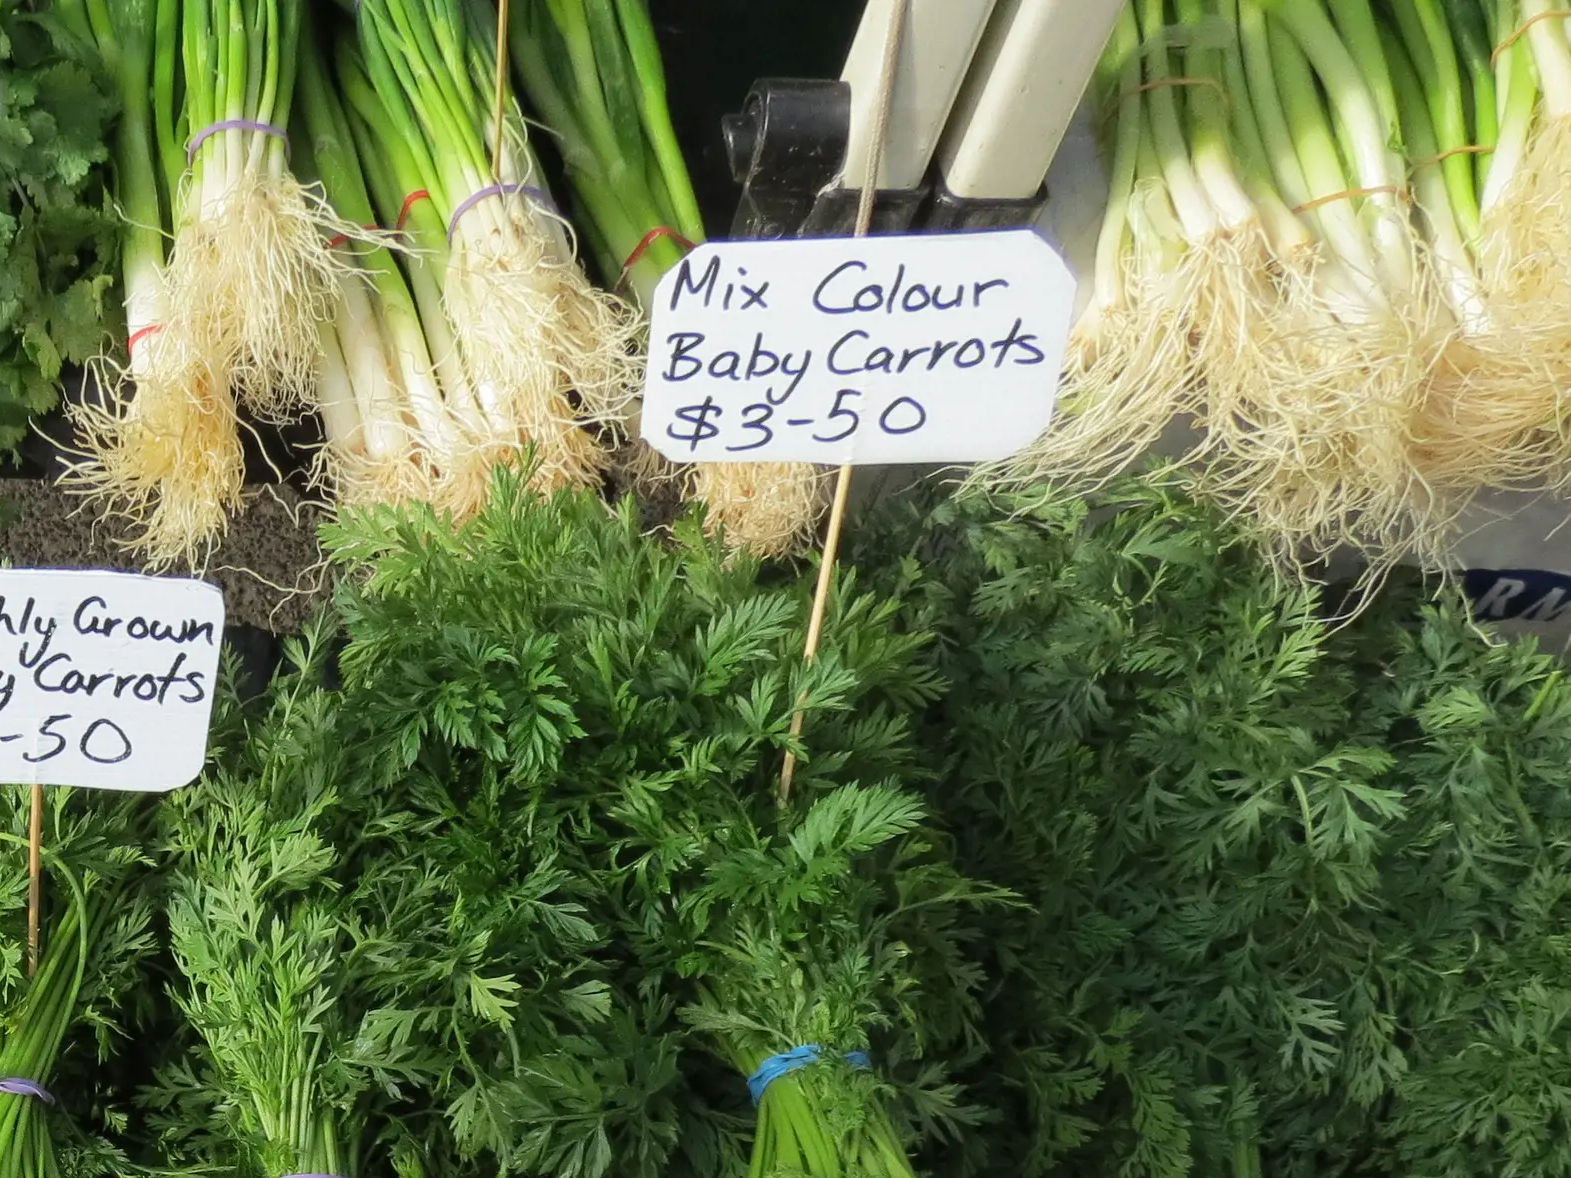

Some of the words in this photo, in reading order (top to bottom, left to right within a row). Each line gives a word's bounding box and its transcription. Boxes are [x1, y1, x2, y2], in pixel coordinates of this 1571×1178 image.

[669, 254, 770, 312] Mix
[812, 260, 1010, 315] Colour
[661, 331, 813, 405] Baby
[826, 317, 1046, 375] Carrots
[665, 388, 928, 452] $3-50
[72, 595, 215, 646] Grown
[32, 652, 206, 705] Carrots
